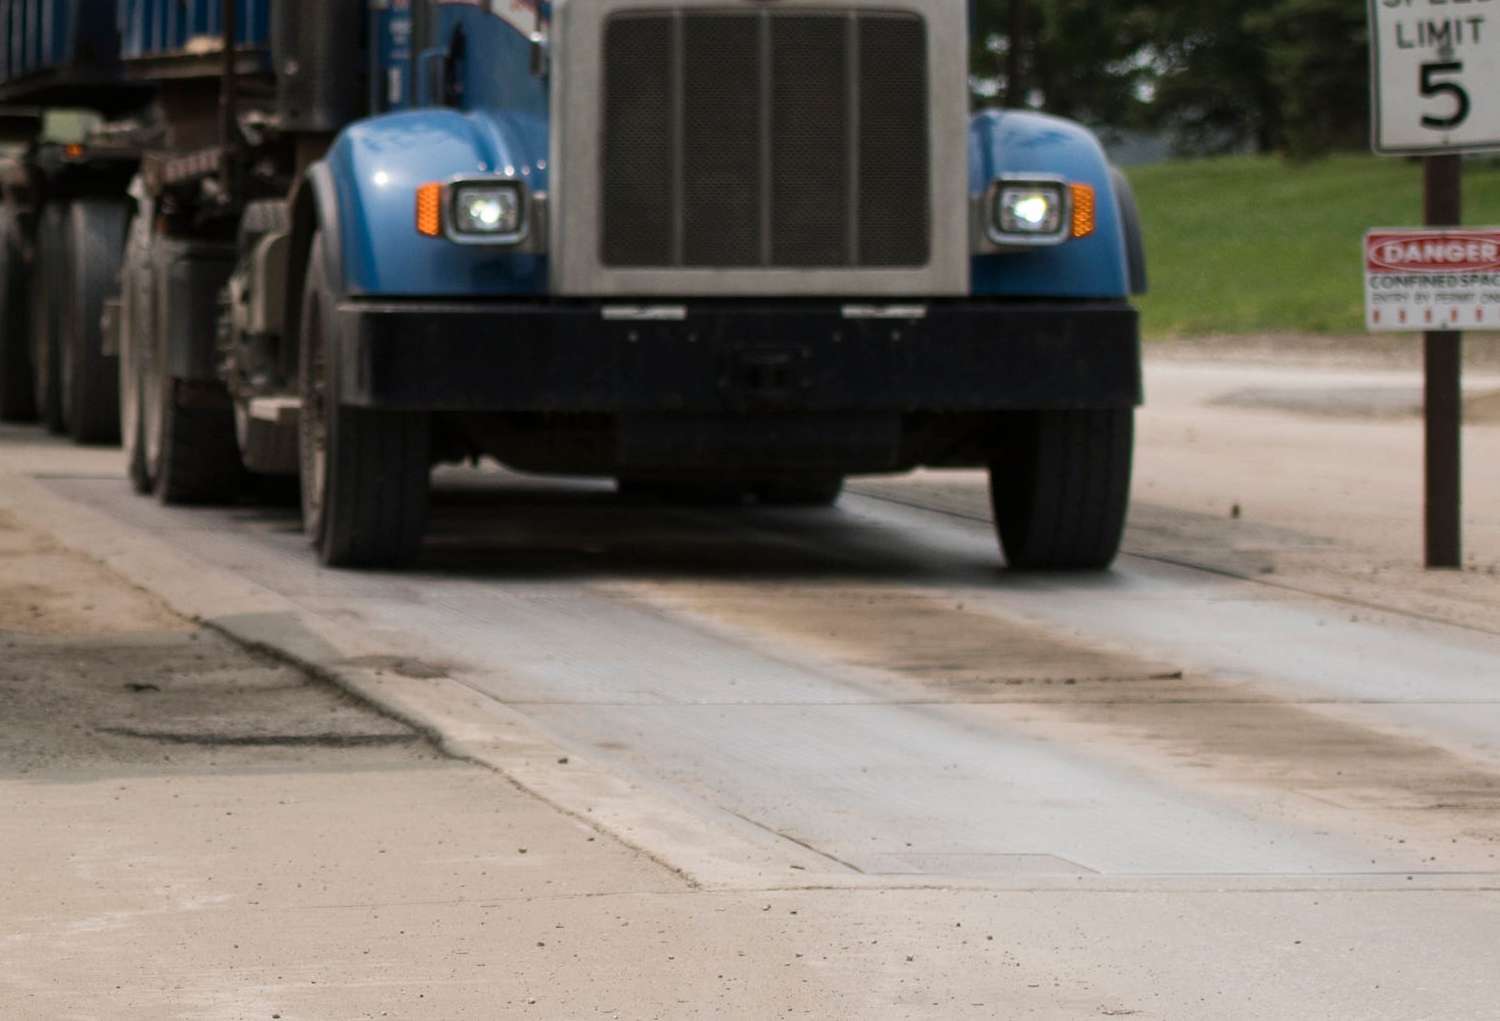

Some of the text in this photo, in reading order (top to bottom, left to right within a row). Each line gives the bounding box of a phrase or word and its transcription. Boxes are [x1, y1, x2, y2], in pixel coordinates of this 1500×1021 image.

[1396, 17, 1485, 48] LIMIT
[1419, 62, 1470, 130] 5
[1383, 241, 1497, 262] DANGER
